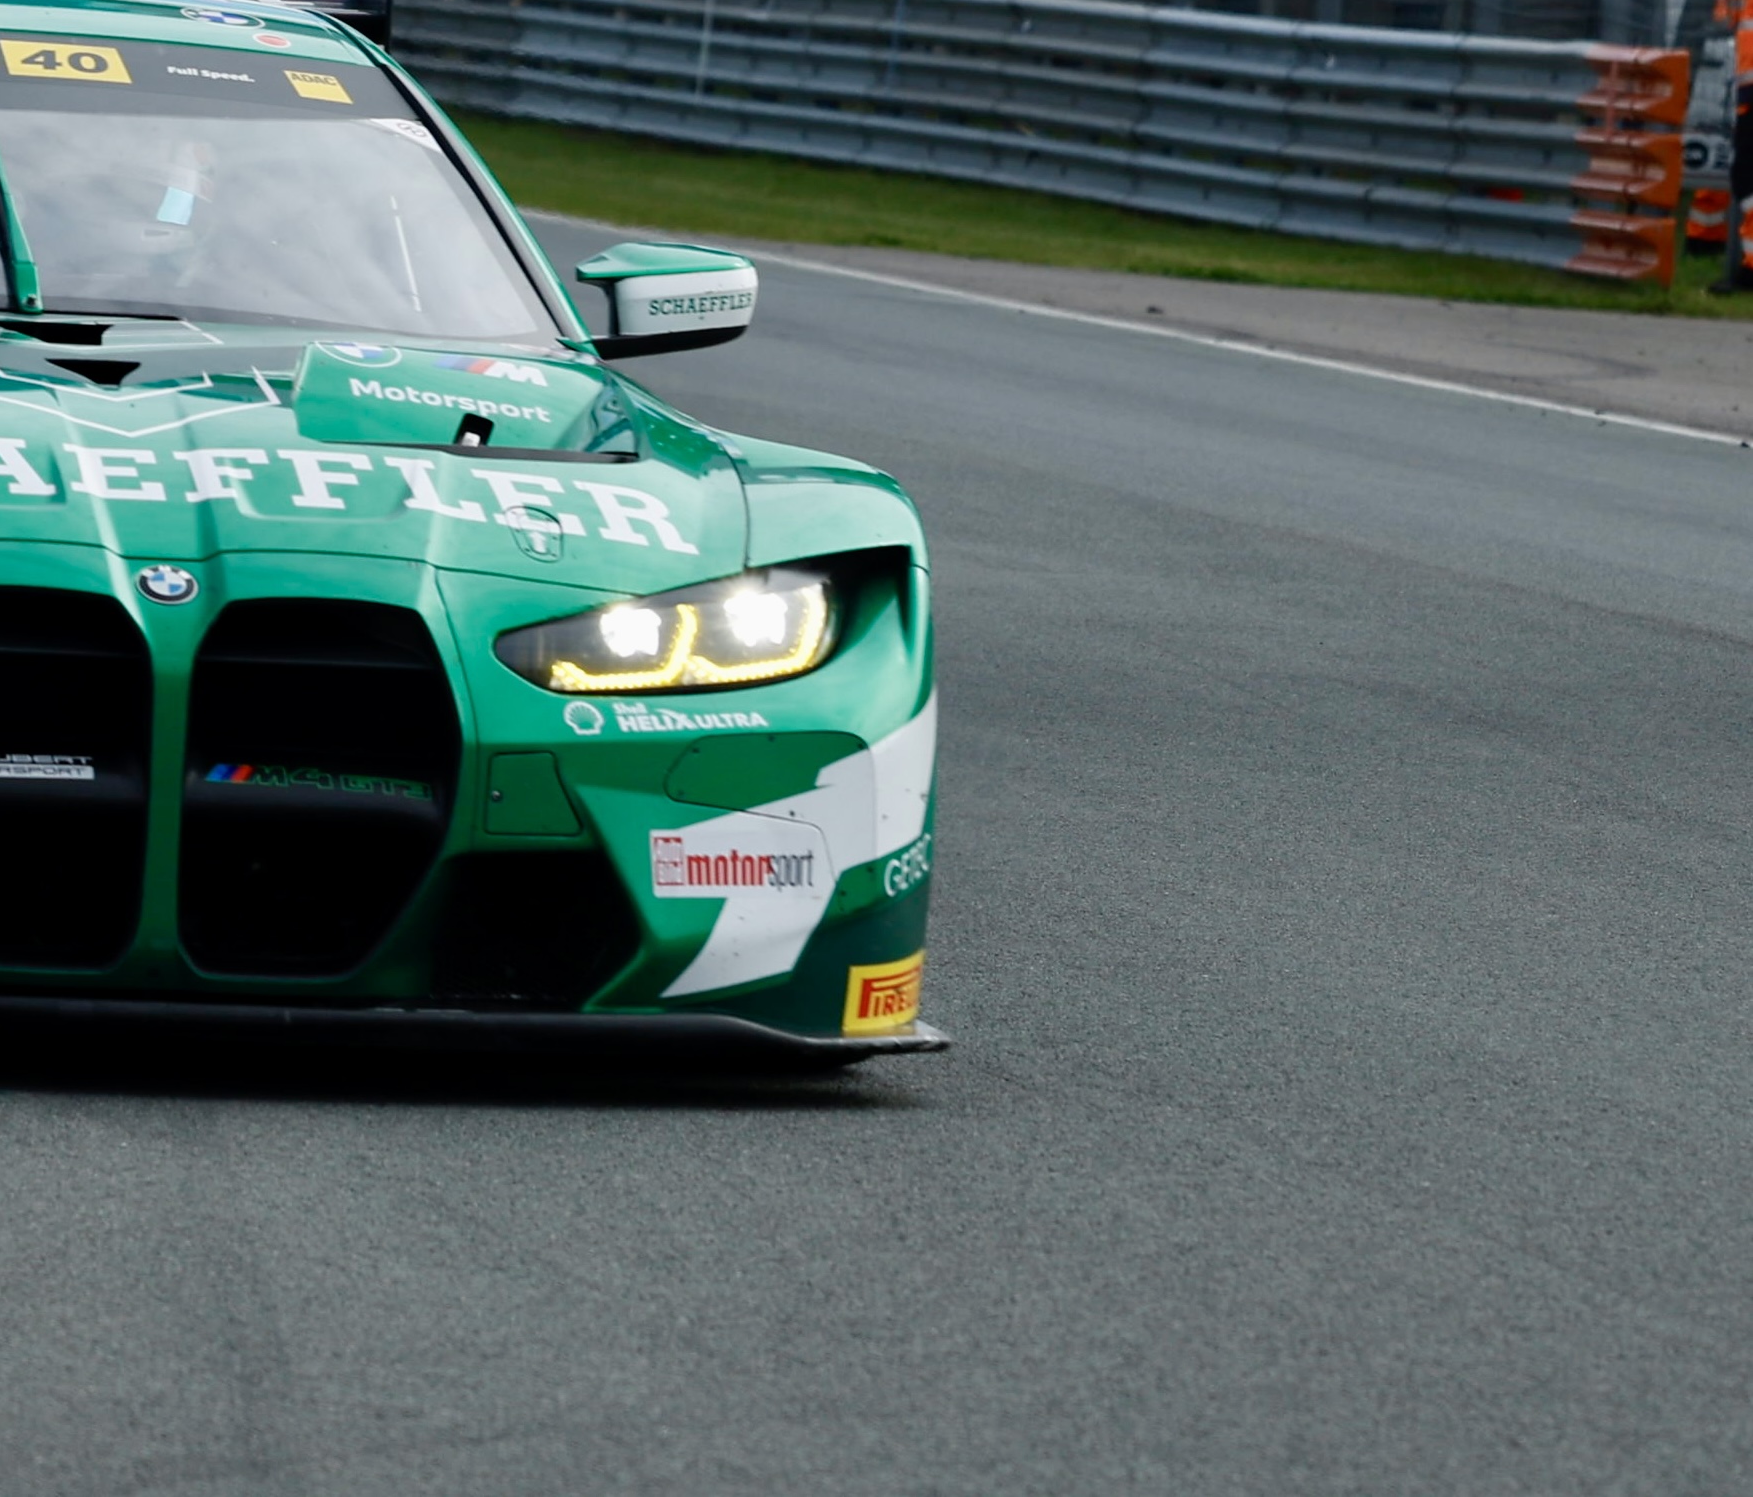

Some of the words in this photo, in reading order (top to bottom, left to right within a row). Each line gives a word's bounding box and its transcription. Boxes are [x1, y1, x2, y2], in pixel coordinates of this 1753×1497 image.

[19, 48, 109, 74] 40
[166, 65, 198, 77] Full
[200, 69, 256, 83] Speed.
[348, 377, 552, 423] Motorsport
[616, 708, 695, 733] HELIX
[692, 711, 770, 730] ULTRA
